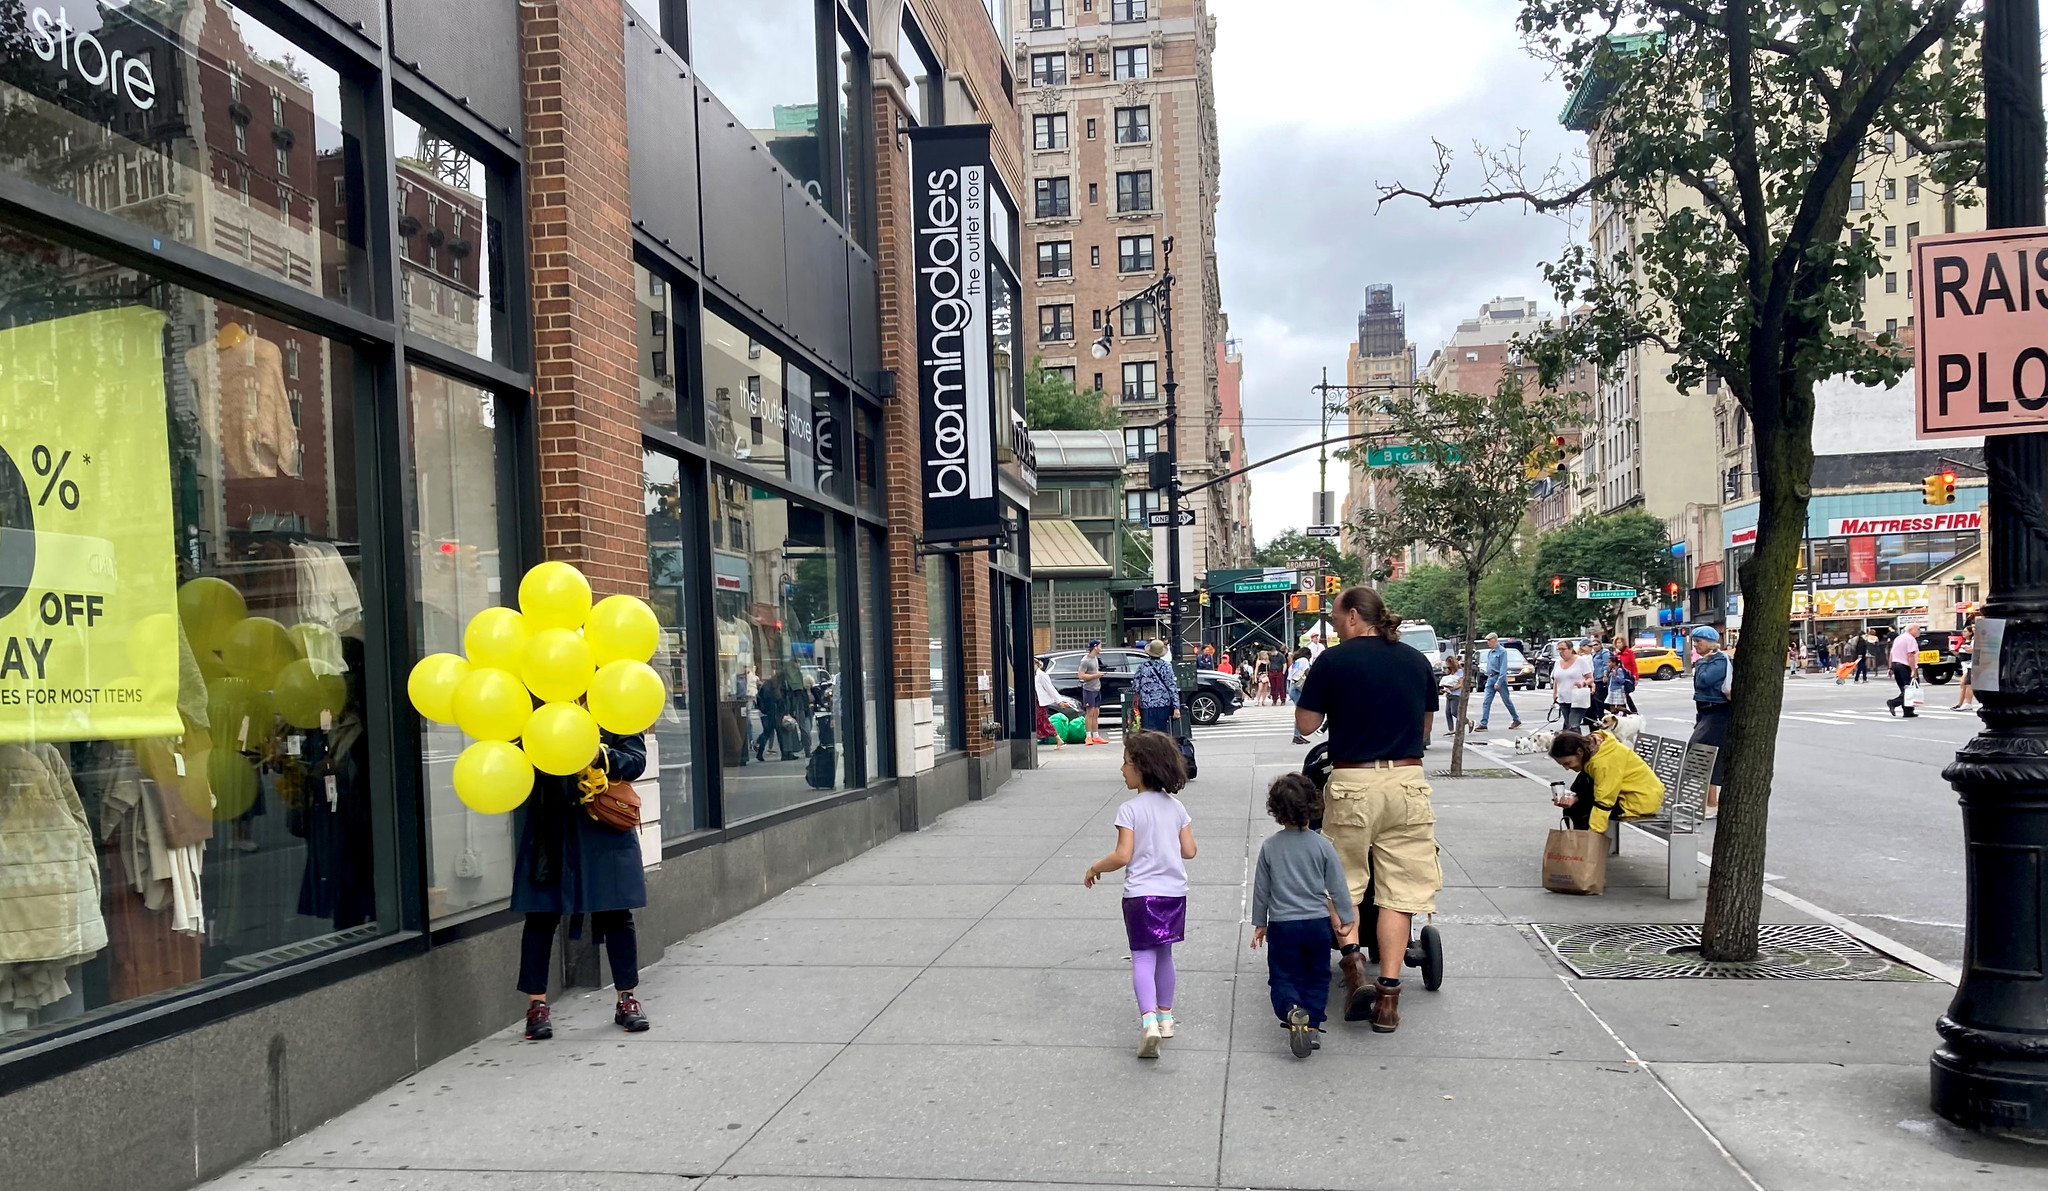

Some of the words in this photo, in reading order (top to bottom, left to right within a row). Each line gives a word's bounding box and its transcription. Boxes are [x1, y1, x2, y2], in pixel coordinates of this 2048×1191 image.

[31, 6, 156, 110] store
[967, 170, 979, 210] store
[966, 216, 980, 263] outlet
[967, 268, 981, 296] the
[739, 379, 757, 415] the
[760, 398, 788, 431] outlet
[790, 410, 812, 442] store
[1154, 515, 1169, 523] ONE
[1285, 560, 1318, 569] BROADWAY
[1238, 583, 1278, 591] Amsterdam
[1794, 588, 1858, 611] RAY'S
[40, 592, 104, 627] OFF
[26, 689, 57, 704] FOR
[61, 689, 100, 704] MOST
[104, 689, 143, 703] ITEMS
